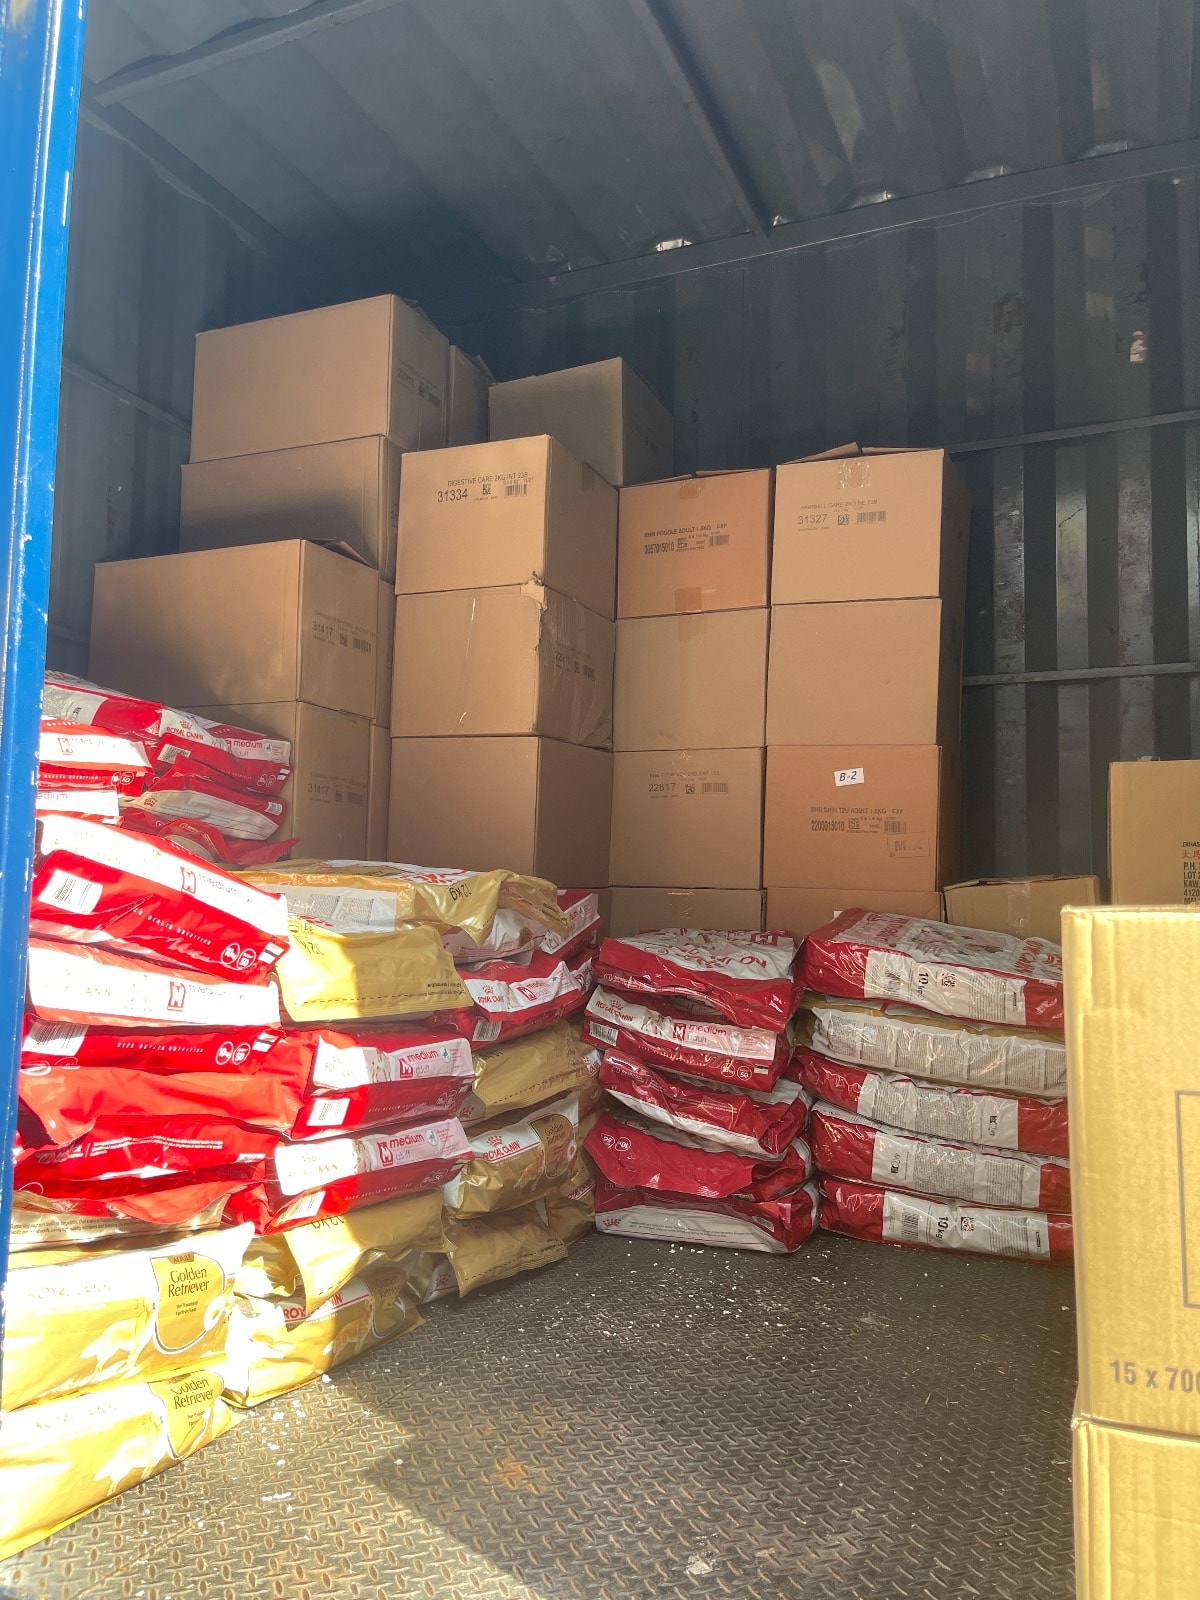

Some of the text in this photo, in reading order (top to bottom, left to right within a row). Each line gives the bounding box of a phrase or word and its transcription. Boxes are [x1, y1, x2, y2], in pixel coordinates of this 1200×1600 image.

[447, 478, 477, 487] DIGESTIVE
[477, 475, 493, 484] CARE
[437, 488, 468, 502] 31334
[798, 514, 828, 524] 31327
[678, 526, 695, 534] ADULT
[233, 740, 263, 749] medium
[839, 770, 857, 782] B-2
[648, 782, 676, 793] 22817
[1183, 861, 1198, 871] P.H.
[1183, 870, 1196, 880] LOT
[688, 1023, 727, 1036] medium
[407, 1049, 440, 1063] medium
[389, 1133, 426, 1149] medium
[173, 1253, 192, 1264] ADULT
[169, 1267, 208, 1284] Golden
[168, 1280, 210, 1298] Retriever
[1109, 1359, 1137, 1386] 15
[1145, 1368, 1159, 1389] x
[173, 1389, 214, 1410] Retriever
